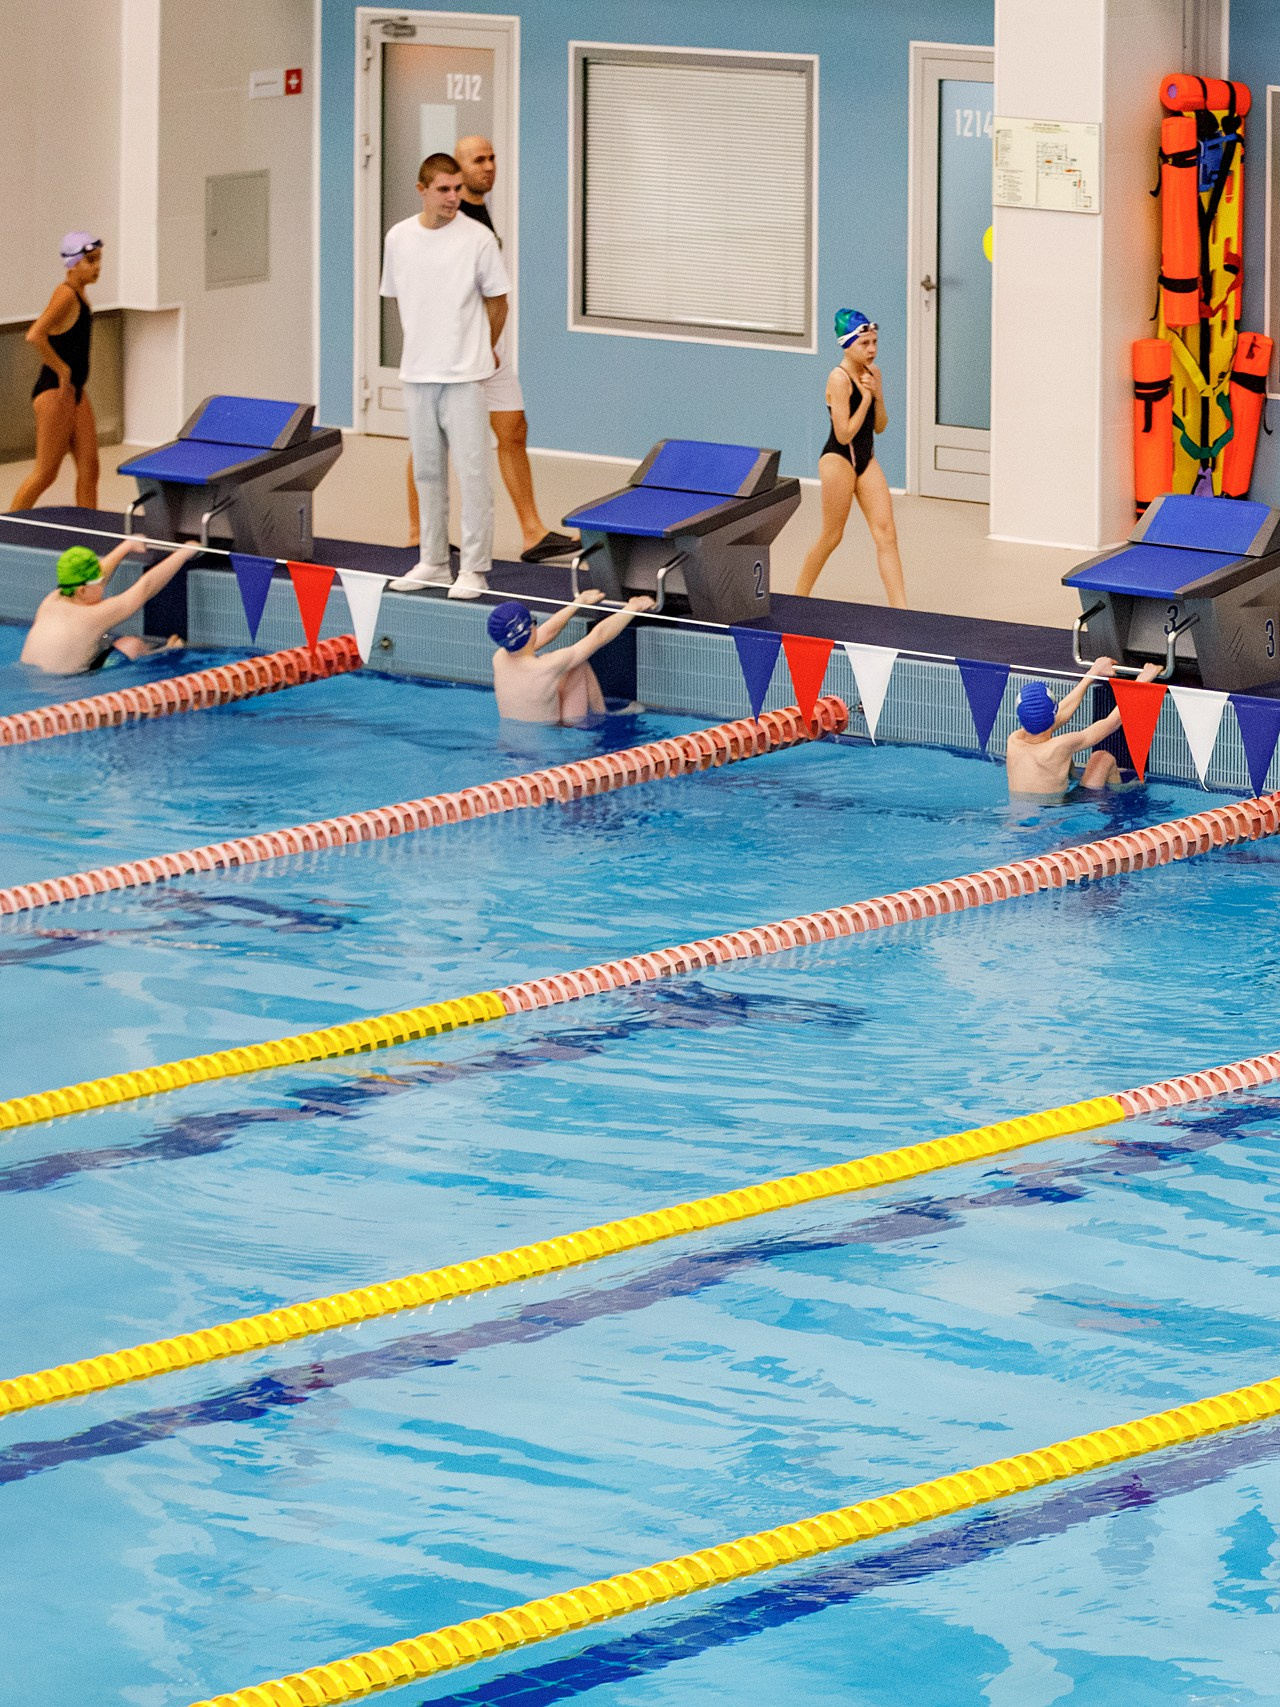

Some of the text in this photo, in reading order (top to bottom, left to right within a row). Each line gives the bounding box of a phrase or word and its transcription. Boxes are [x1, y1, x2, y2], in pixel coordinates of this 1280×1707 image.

[446, 73, 482, 101] 1212
[954, 109, 992, 138] 1214
[752, 560, 764, 600] 2
[1164, 605, 1179, 636] 3
[1265, 618, 1275, 659] 3
